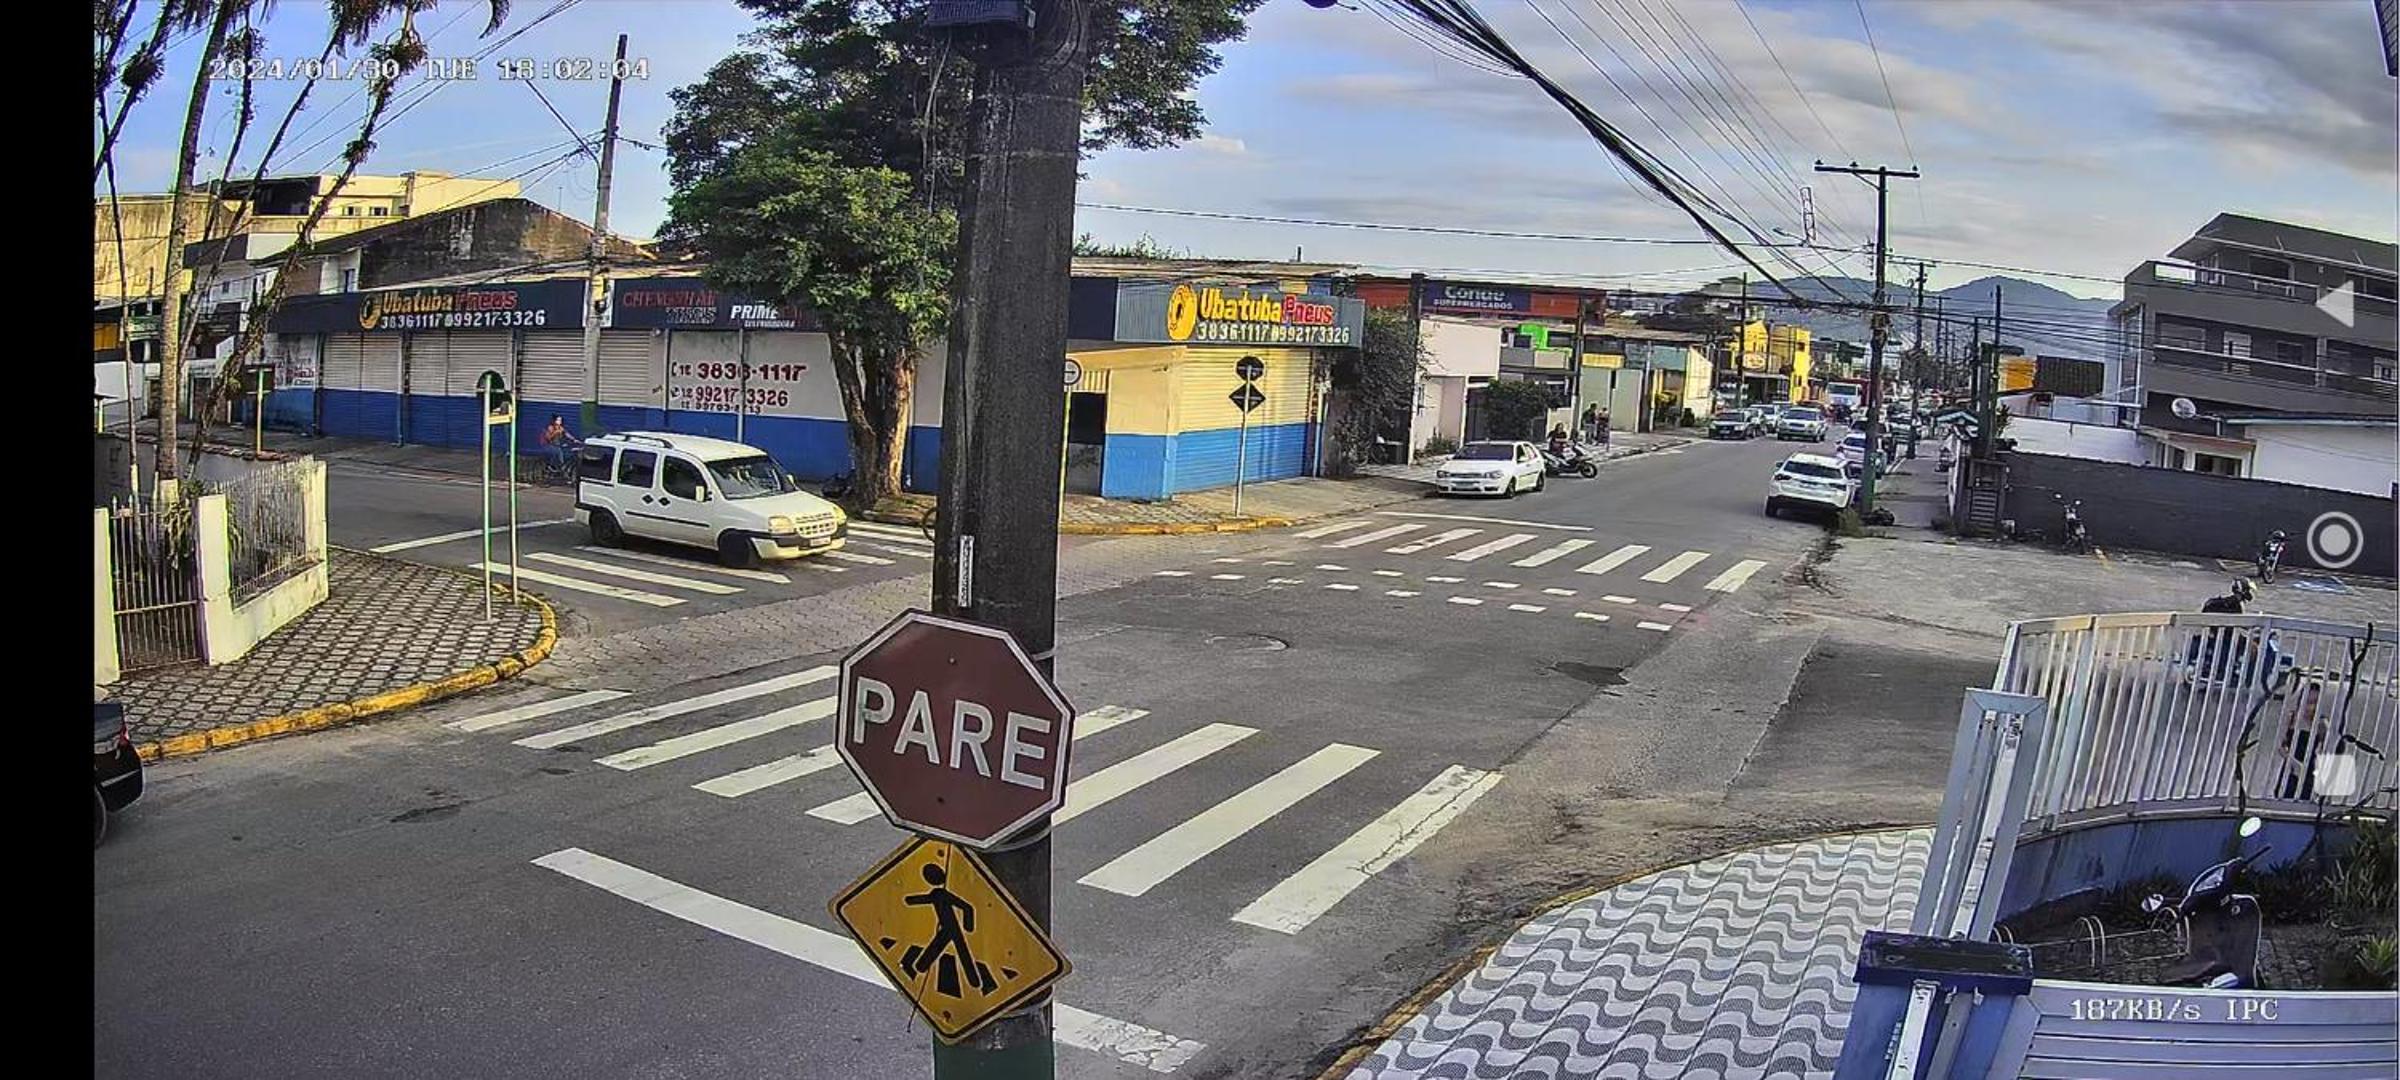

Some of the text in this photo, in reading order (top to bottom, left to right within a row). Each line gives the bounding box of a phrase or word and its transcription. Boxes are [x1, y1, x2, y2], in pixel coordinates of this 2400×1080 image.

[382, 289, 452, 313] Ubatuba
[730, 304, 780, 320] PRIME
[1201, 287, 1335, 325] Ubatuba Pneus
[853, 676, 1051, 790] PARE
